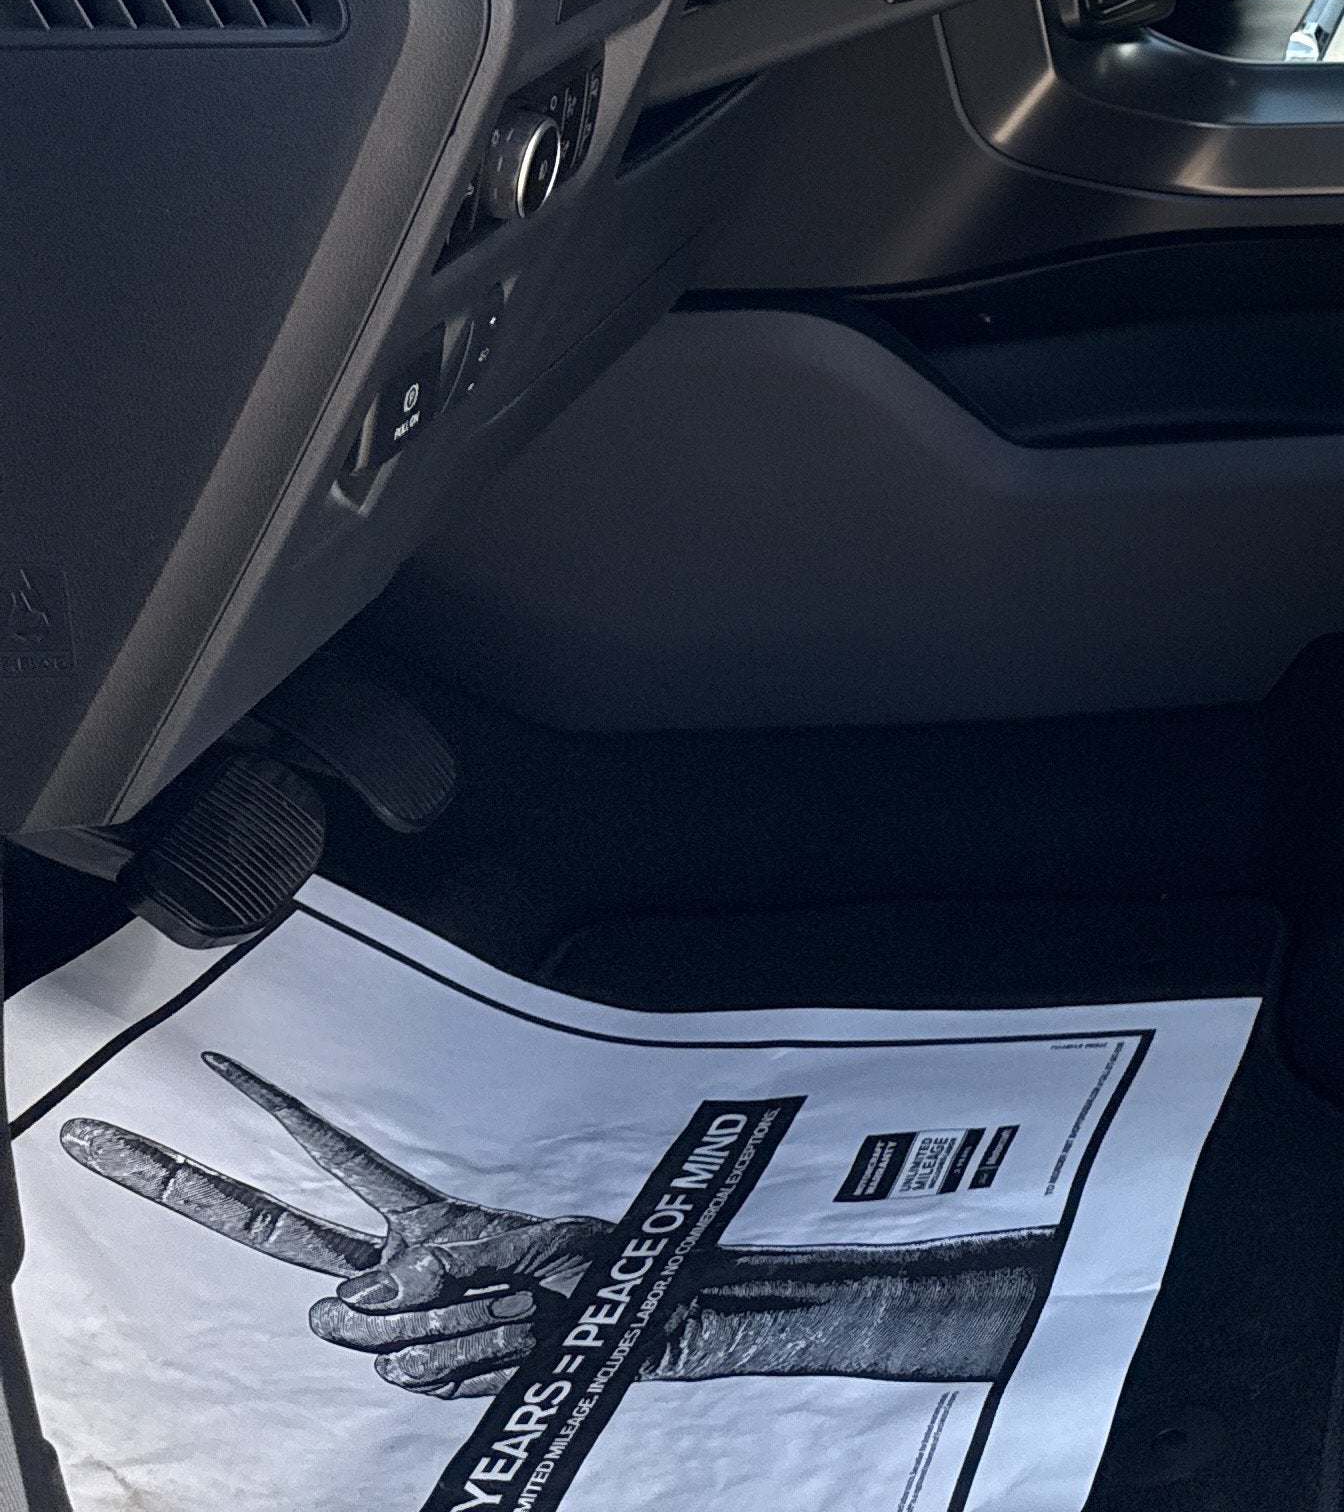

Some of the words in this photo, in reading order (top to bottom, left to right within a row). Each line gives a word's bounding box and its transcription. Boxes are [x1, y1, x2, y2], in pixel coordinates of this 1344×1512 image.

[865, 1141, 897, 1194] WARRANTY
[900, 1138, 932, 1192] UNLIMITED
[912, 1137, 949, 1190] MILEAGE
[589, 1329, 641, 1393] INCLUDES
[725, 1106, 782, 1191] EXCEPTIONS.
[450, 1381, 573, 1512] YEARS
[562, 1238, 668, 1348] PEACE
[642, 1193, 696, 1234] OF
[671, 1113, 749, 1189] MIND
